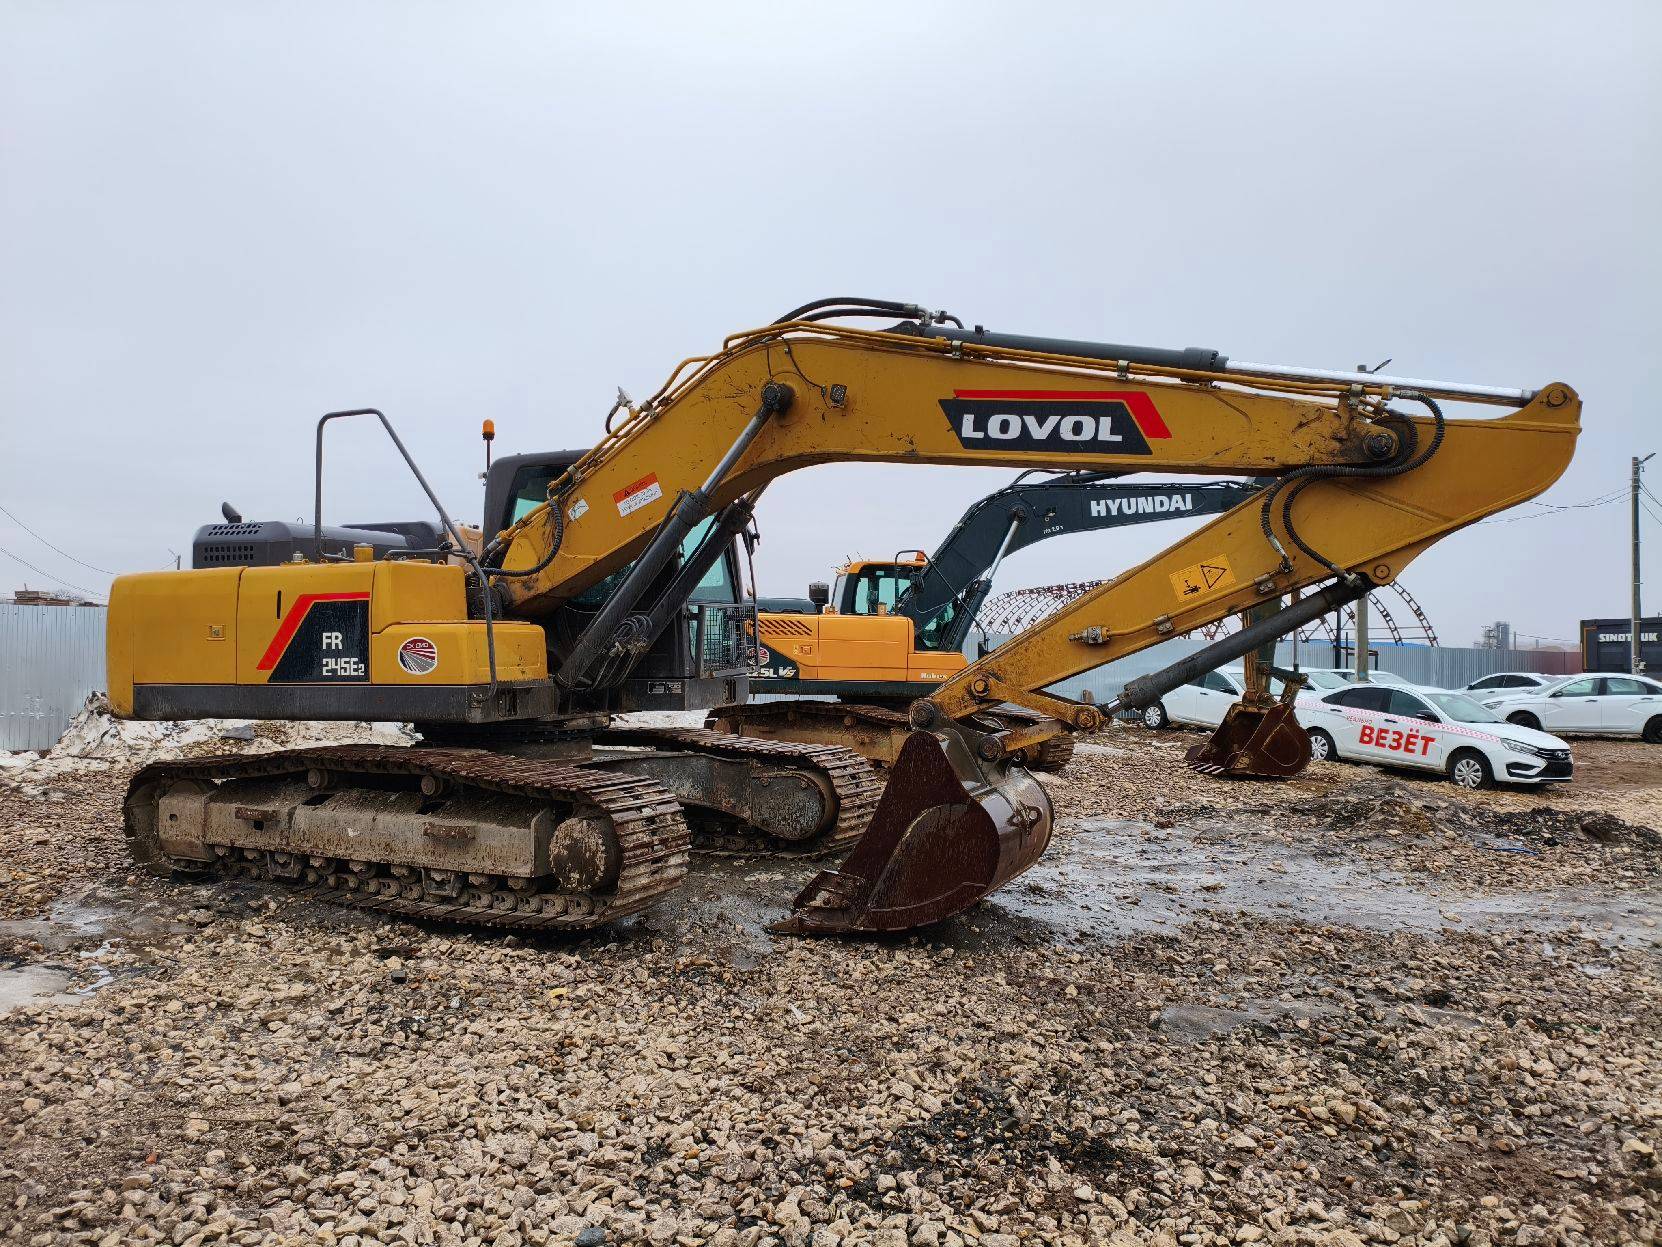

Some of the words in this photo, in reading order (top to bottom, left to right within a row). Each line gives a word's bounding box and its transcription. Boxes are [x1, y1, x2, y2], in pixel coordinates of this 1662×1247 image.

[961, 413, 1123, 442] LOVOL
[1090, 493, 1193, 517] HYUNDAI
[322, 631, 343, 650] FR
[1598, 632, 1658, 642] SINOTUK
[1359, 725, 1437, 757] ВЕЗЁТ
